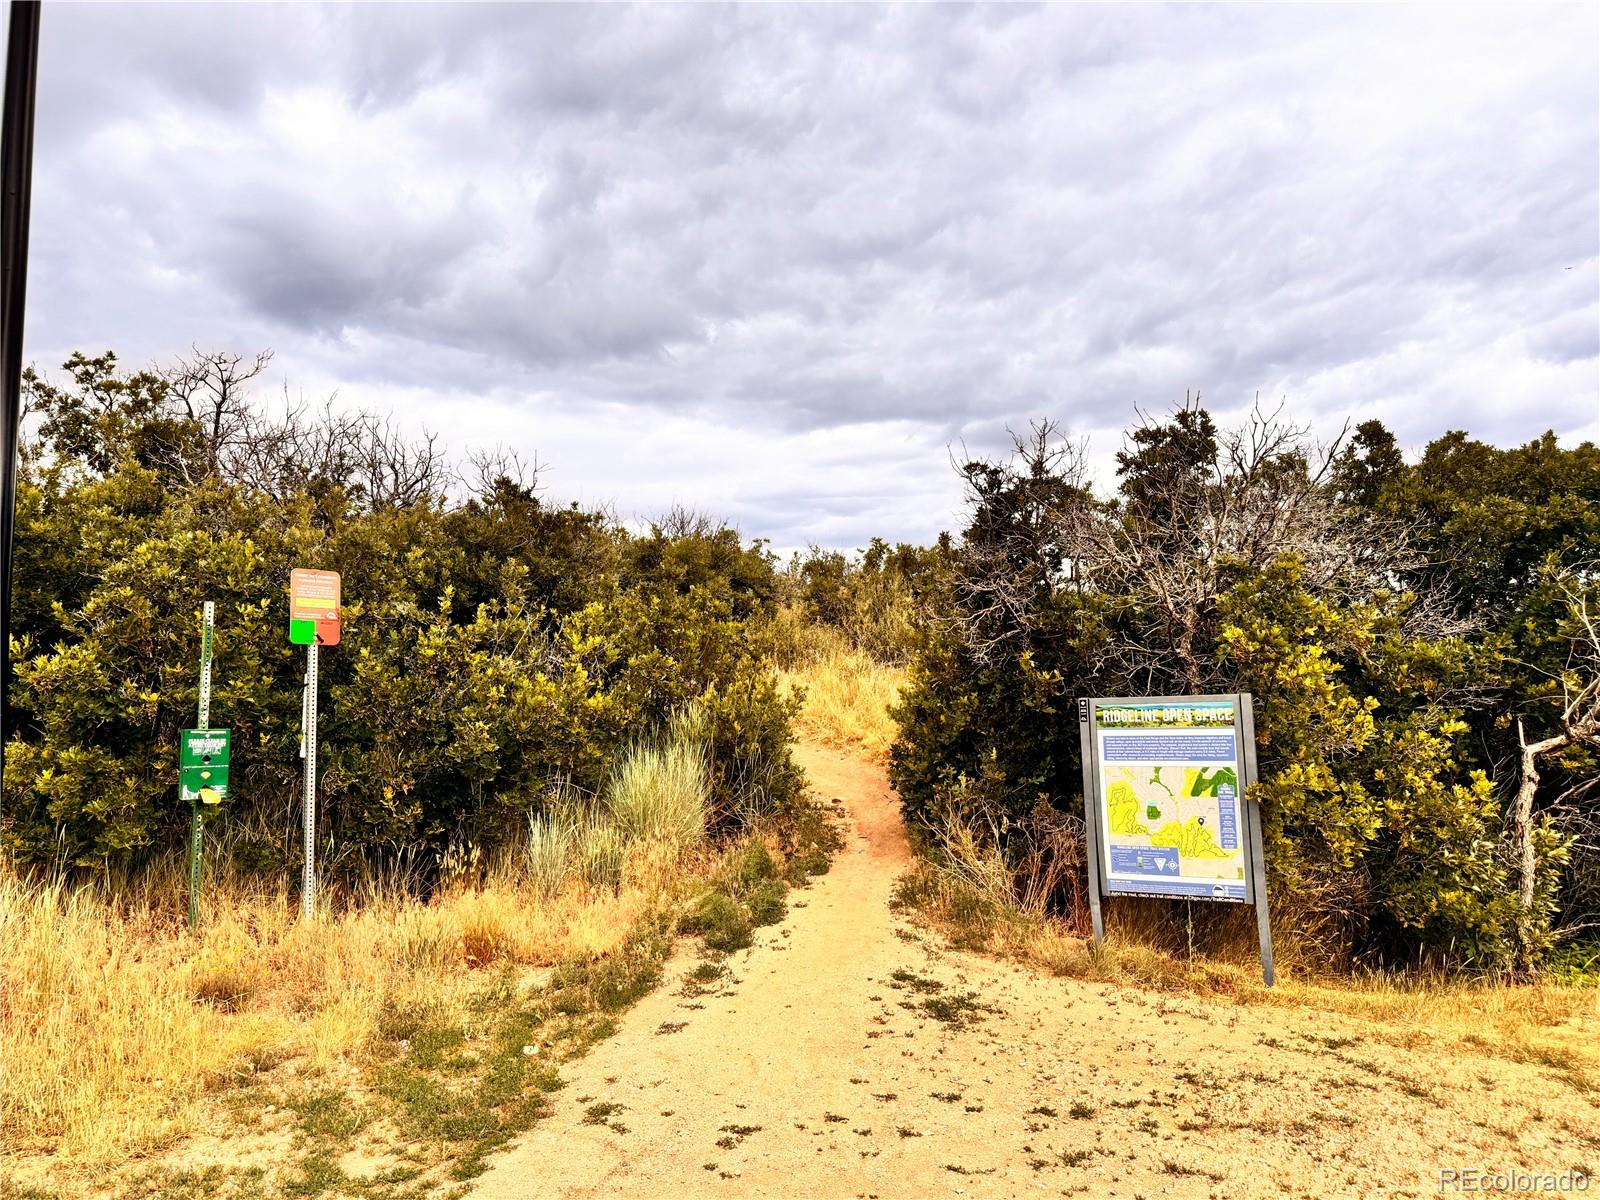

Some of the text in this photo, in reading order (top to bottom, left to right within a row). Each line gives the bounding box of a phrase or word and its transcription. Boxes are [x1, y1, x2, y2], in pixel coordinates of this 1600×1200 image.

[1102, 707, 1232, 723] RIDGELINE OPEN SPACE
